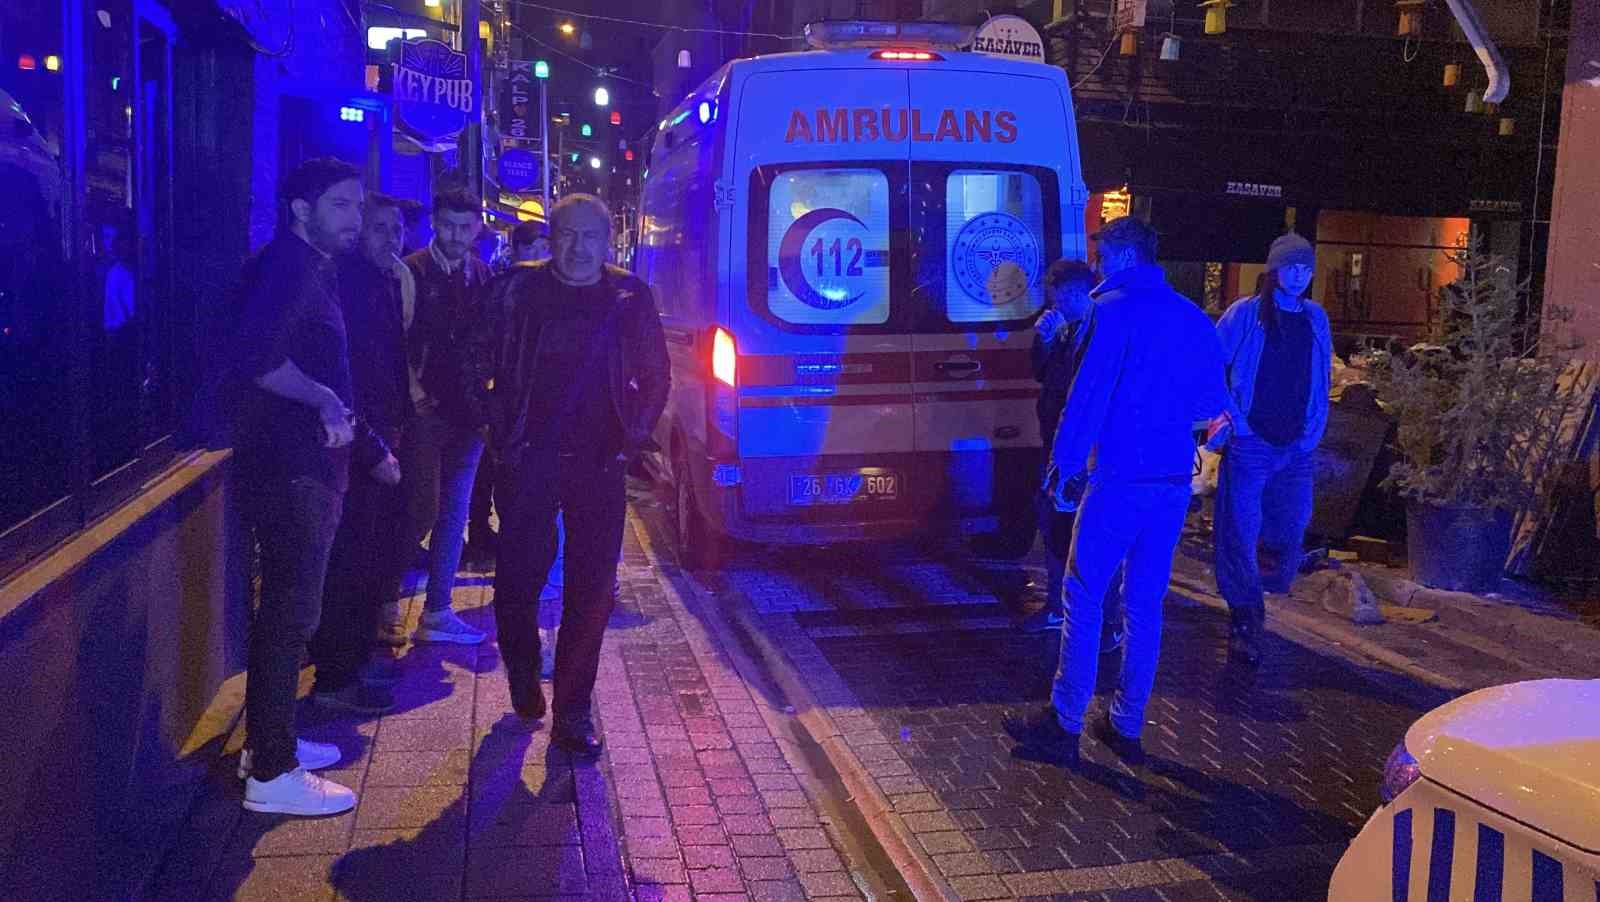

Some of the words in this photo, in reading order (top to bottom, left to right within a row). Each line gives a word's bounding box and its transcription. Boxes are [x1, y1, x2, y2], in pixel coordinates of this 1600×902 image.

[973, 36, 1041, 58] KASAVER
[785, 107, 1018, 143] AMBULANS
[811, 238, 863, 277] 112
[802, 478, 822, 497] 26
[867, 475, 896, 495] 602
